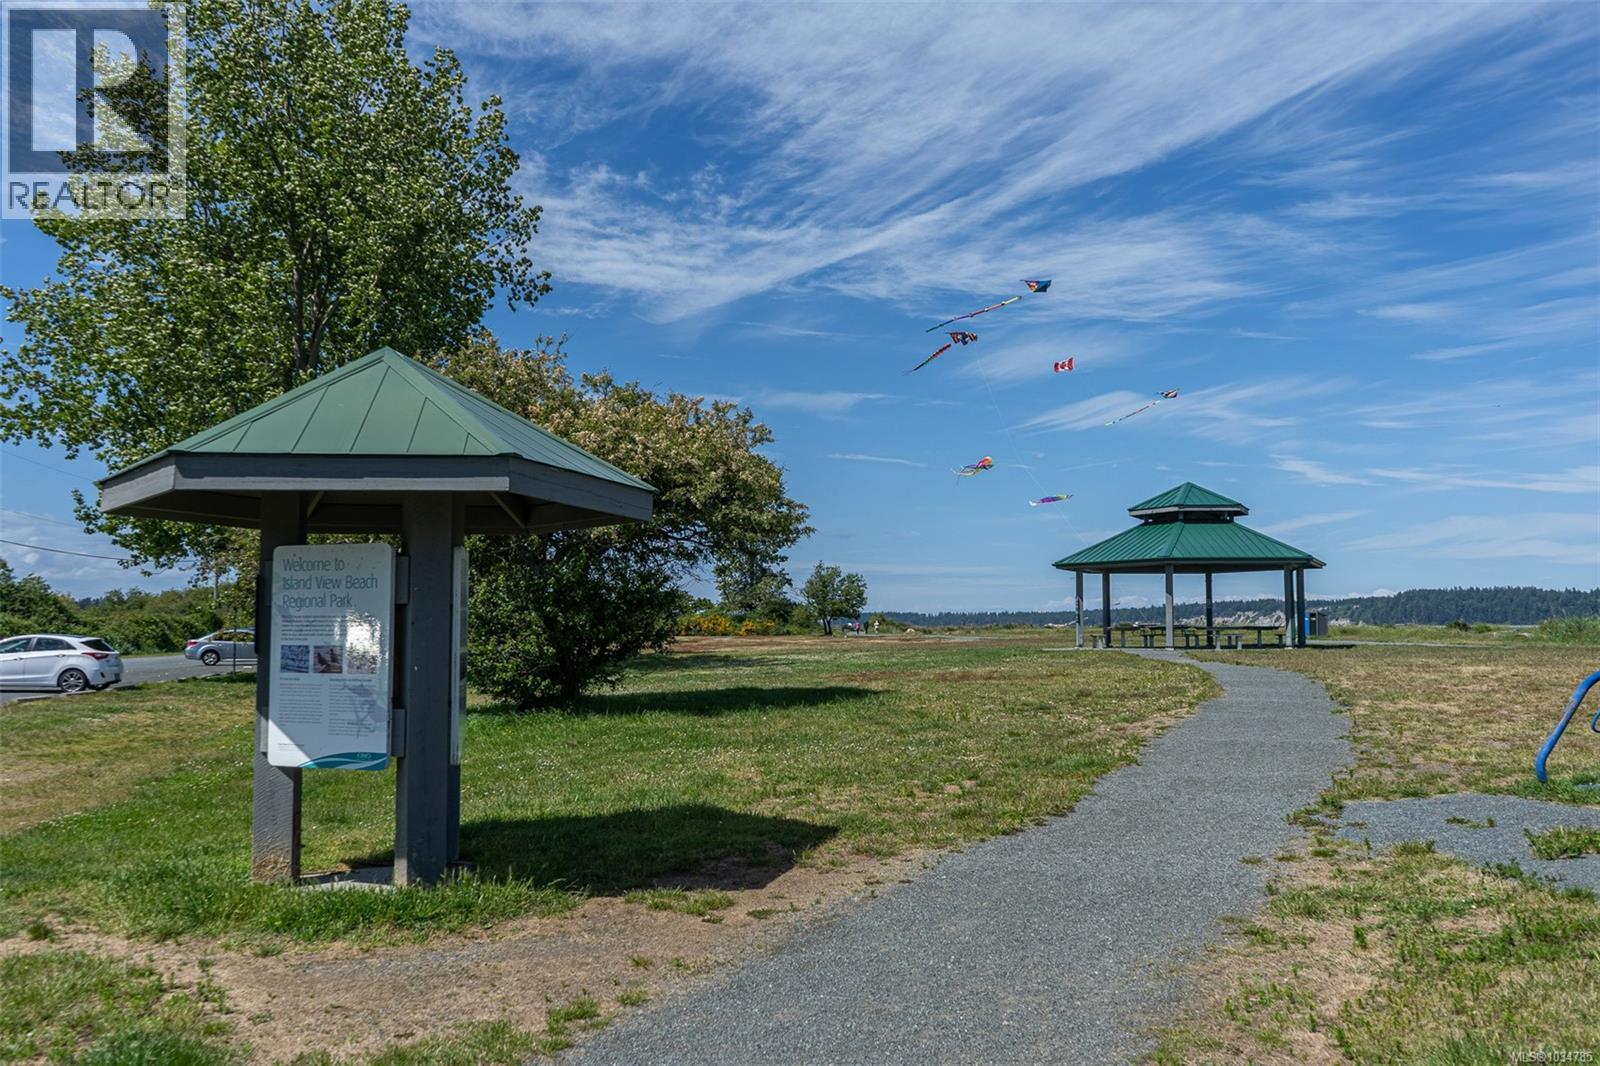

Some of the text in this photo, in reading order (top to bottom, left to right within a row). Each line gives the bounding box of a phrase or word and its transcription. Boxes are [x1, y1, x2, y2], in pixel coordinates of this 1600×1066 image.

[282, 557, 345, 572] Welcome to
[282, 573, 379, 590] Island View Beach
[282, 592, 353, 612] Regional Park
